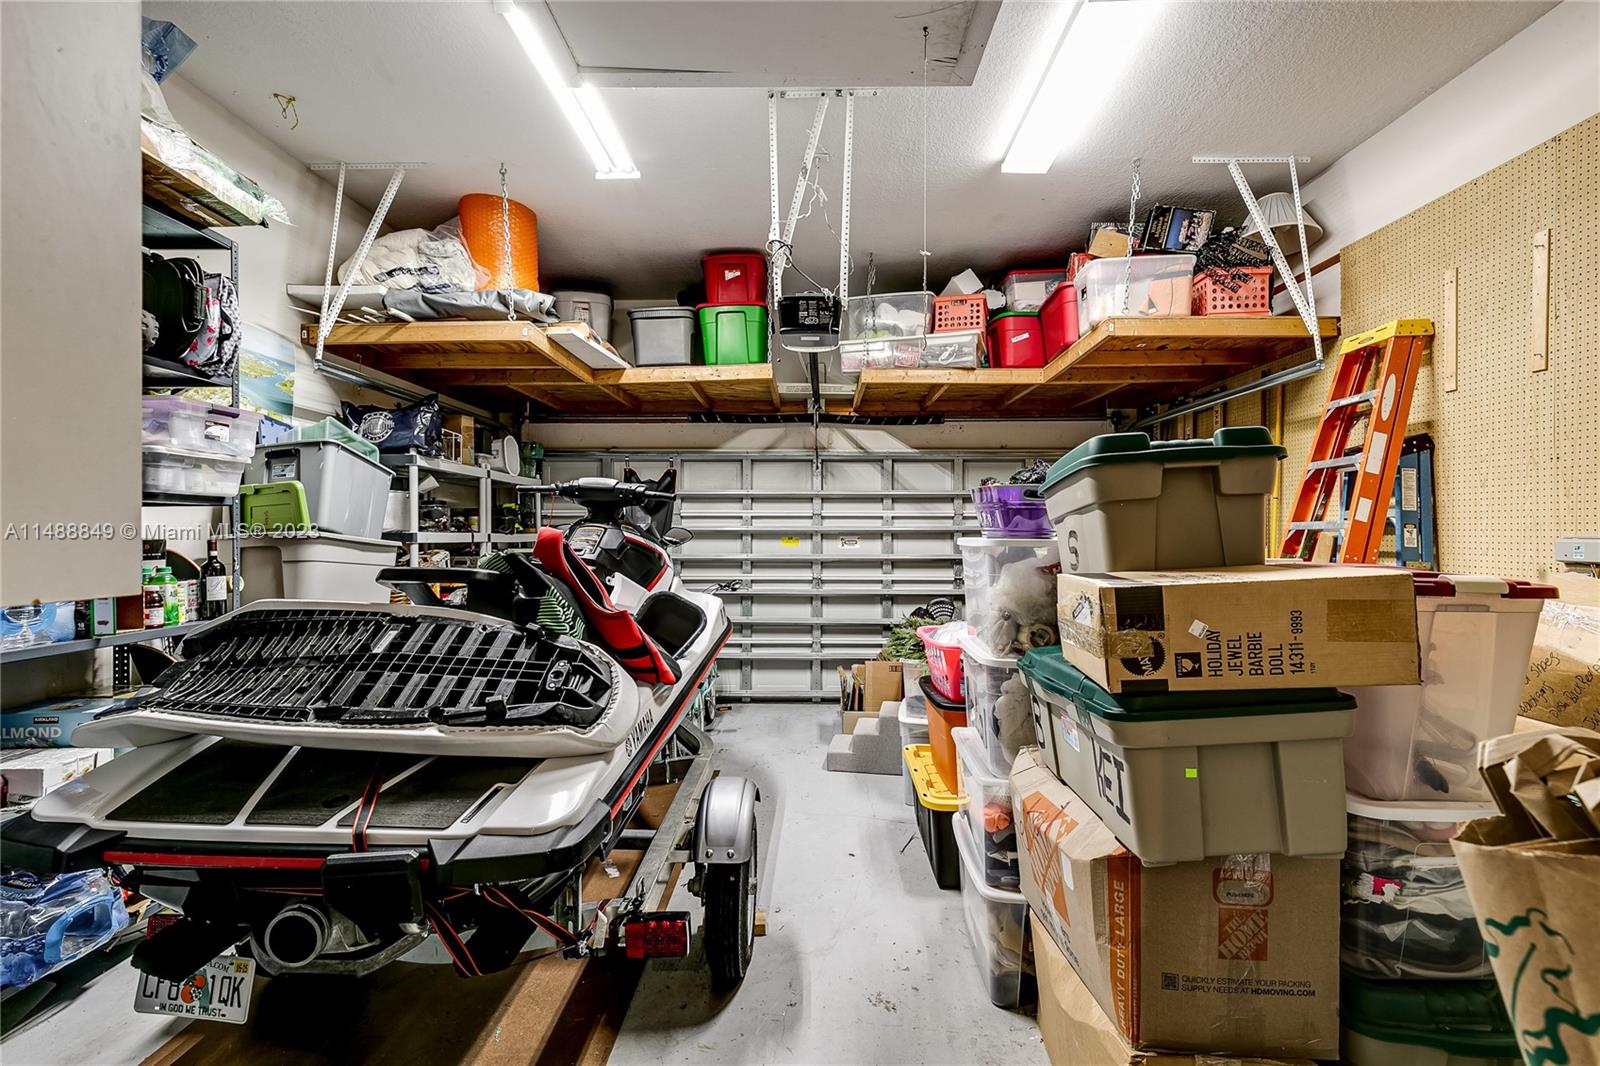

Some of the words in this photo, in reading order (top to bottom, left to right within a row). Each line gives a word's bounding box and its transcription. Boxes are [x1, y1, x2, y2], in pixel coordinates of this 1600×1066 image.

[1206, 629, 1223, 677] HOLIDAY
[1226, 634, 1244, 677] JEWEL
[1246, 631, 1265, 676] BARBIE
[1268, 643, 1285, 676] DOLL
[0, 726, 62, 739] LMOND
[630, 708, 655, 751] YAMAHA
[1113, 879, 1126, 937] LARGE
[1116, 942, 1127, 979] DUTY
[208, 974, 245, 1008] 1QK
[1181, 975, 1216, 985] QUICKLY
[1216, 976, 1255, 986] ESTIMATE
[1255, 978, 1278, 987] YOUR
[1278, 979, 1311, 988] PACKING
[1181, 984, 1212, 994] SUPPLY
[1213, 985, 1239, 994] NEEDS
[1240, 986, 1250, 995] AT
[1251, 988, 1316, 997] HDMOVING.COM
[168, 1004, 184, 1013] GOD
[185, 1005, 196, 1015] WE
[198, 1006, 222, 1018] TRUST
[1115, 984, 1127, 1034] HEAVY
